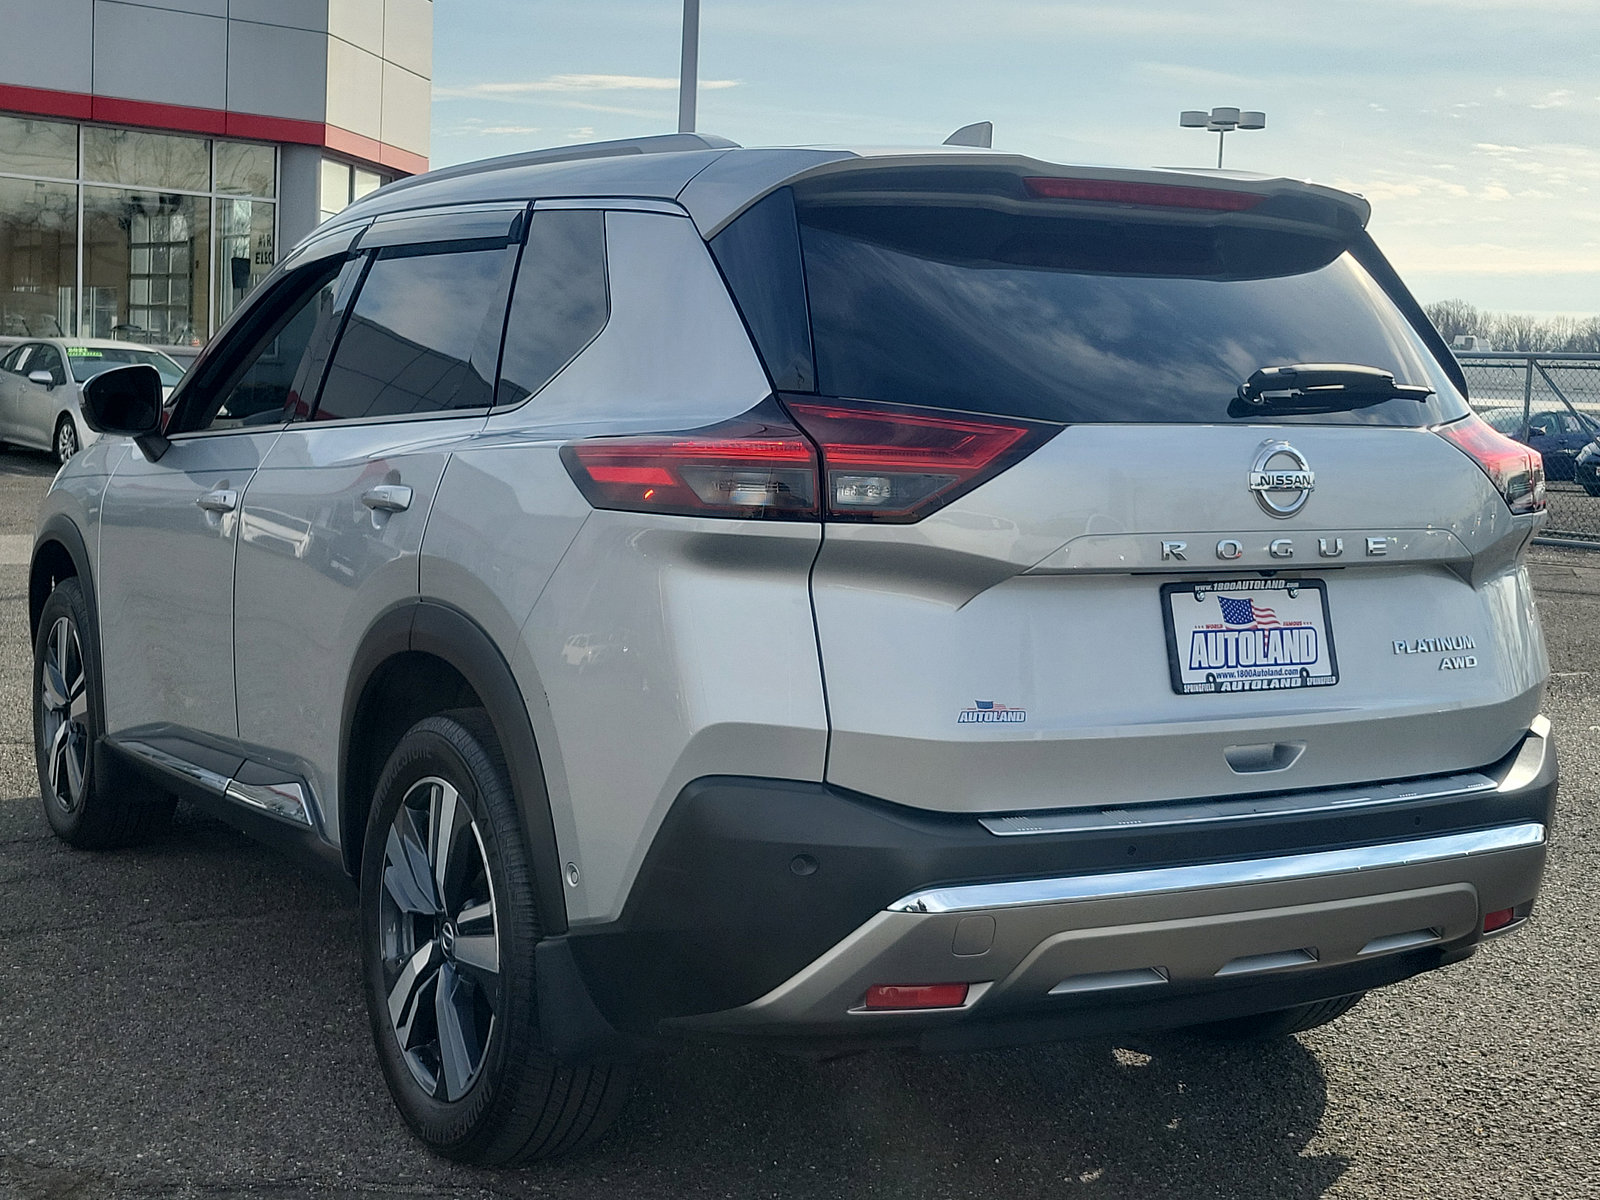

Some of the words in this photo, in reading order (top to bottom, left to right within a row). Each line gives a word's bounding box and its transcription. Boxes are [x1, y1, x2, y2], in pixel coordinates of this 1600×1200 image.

[1259, 474, 1311, 486] NISSAN
[1160, 536, 1388, 561] ROGUE
[1189, 626, 1318, 670] AUTOLAND
[1392, 635, 1476, 655] PLATINUM
[1438, 655, 1478, 670] AWD
[1215, 667, 1299, 680] www.1800Autoland.com
[1220, 677, 1302, 692] AUTOLAND
[957, 710, 1026, 724] AUTOLAND
